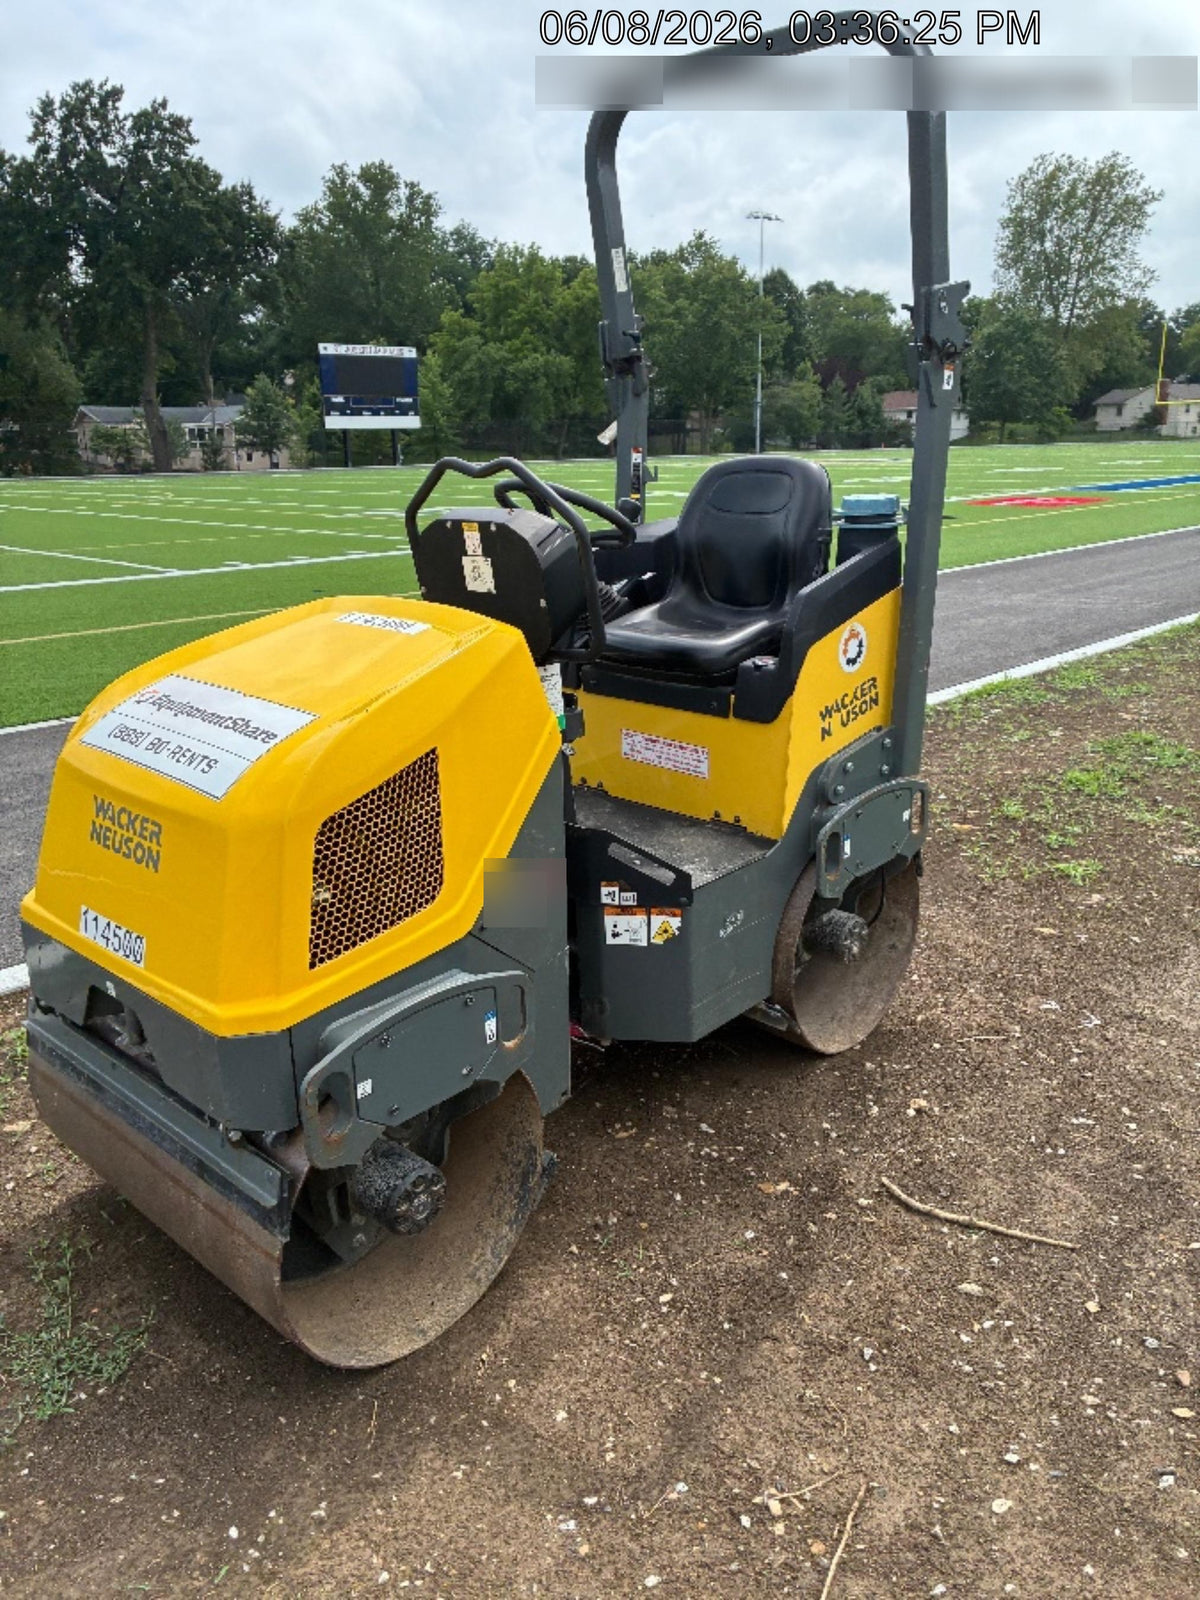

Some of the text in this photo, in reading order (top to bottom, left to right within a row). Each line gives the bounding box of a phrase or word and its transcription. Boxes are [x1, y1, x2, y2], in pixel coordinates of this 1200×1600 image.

[148, 692, 278, 744] EquipmentShare
[818, 676, 878, 723] WACKER
[820, 691, 879, 742] NUSON
[144, 736, 219, 774] 80-RENTS
[93, 793, 163, 848] WACKER
[89, 819, 161, 874] NEUSON
